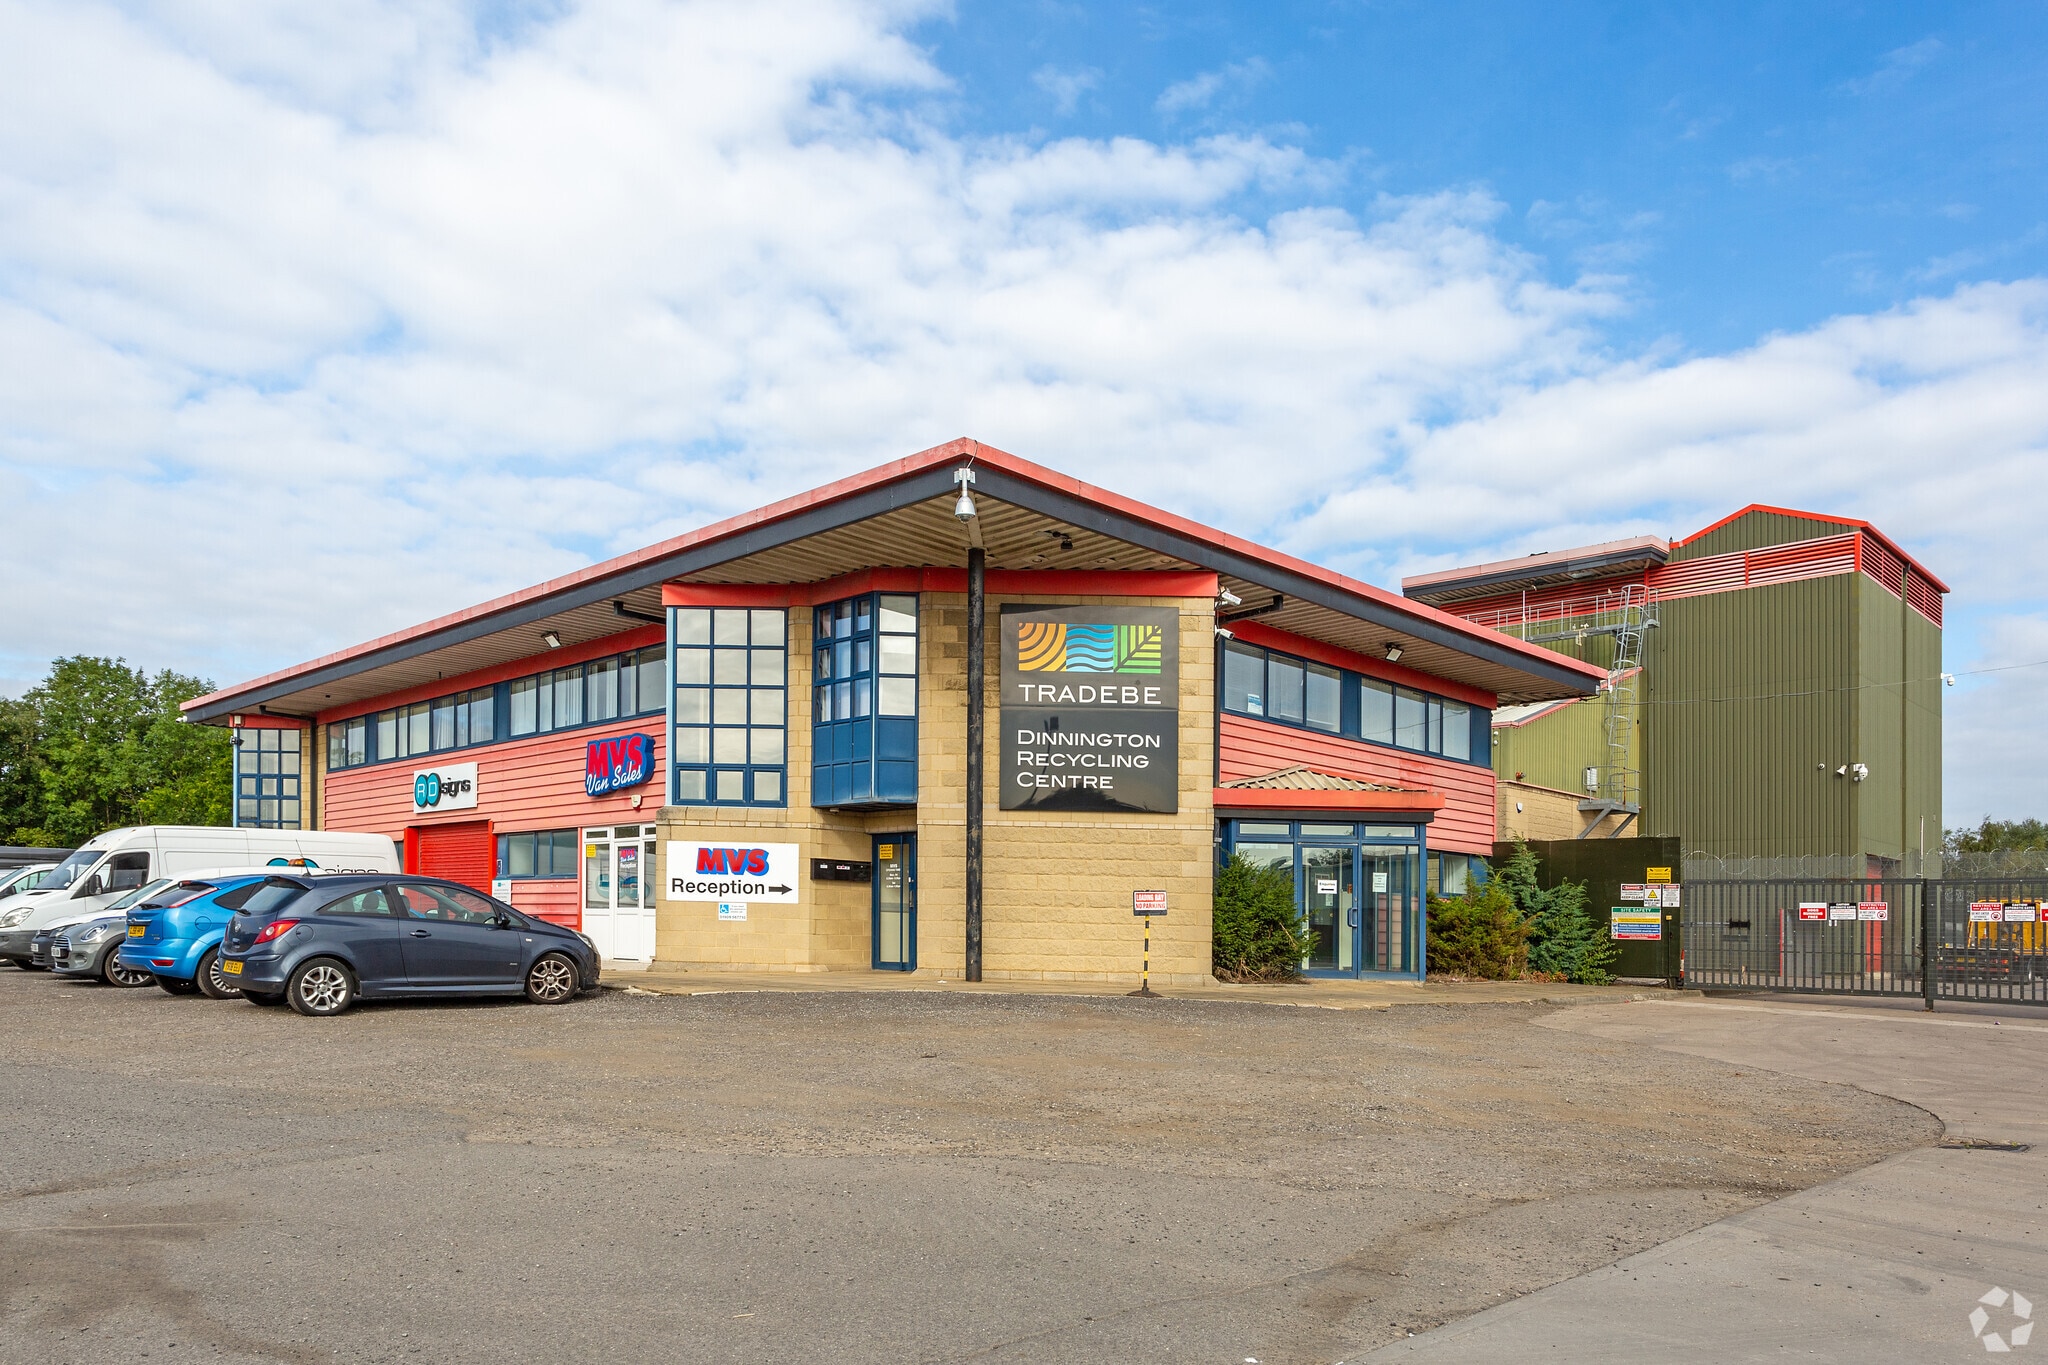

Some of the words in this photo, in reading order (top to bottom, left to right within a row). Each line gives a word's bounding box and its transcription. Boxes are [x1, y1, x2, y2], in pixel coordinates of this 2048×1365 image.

[1018, 684, 1162, 705] TRADEBE
[1017, 729, 1161, 748] DINNINGTON
[588, 736, 643, 778] MVS
[1017, 751, 1150, 769] RECYCLING
[586, 773, 609, 794] Van
[612, 760, 643, 787] Sales
[1016, 771, 1114, 789] CENTRE
[696, 847, 770, 877] MVS
[671, 877, 765, 897] Reception
[1136, 893, 1154, 902] LOADING
[1154, 893, 1165, 902] BAY
